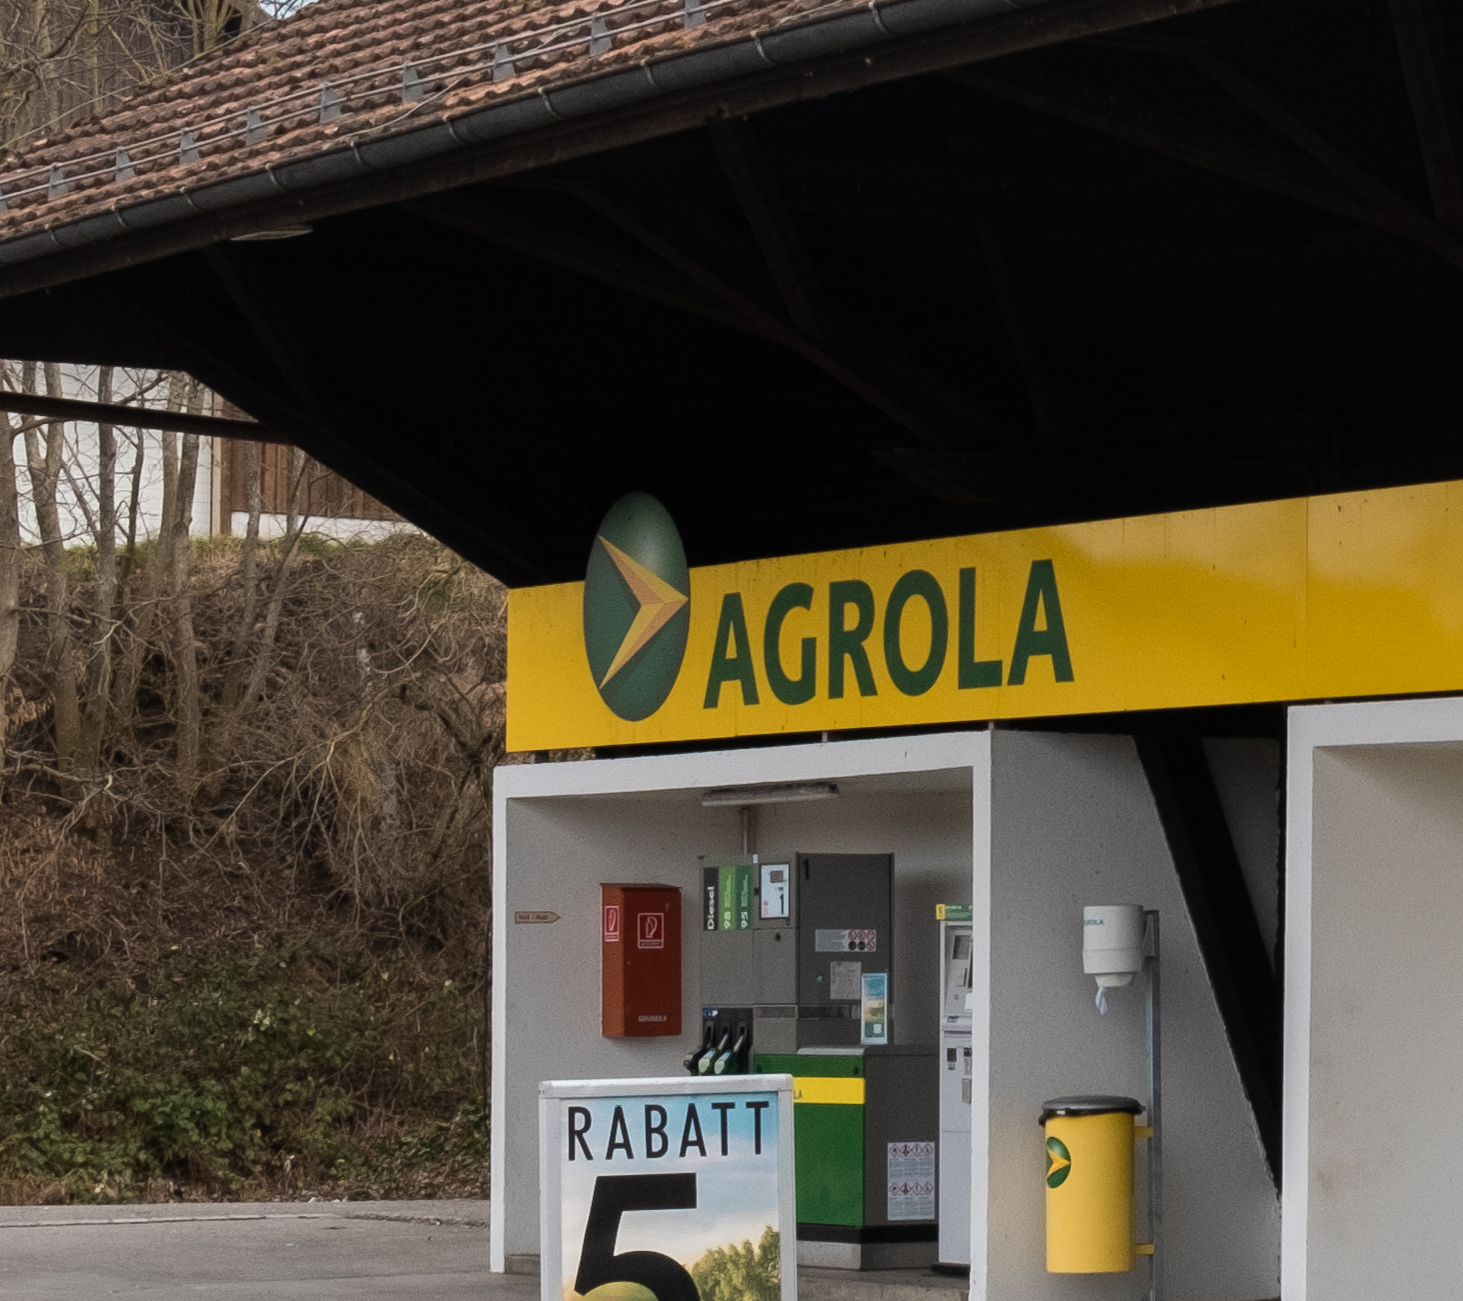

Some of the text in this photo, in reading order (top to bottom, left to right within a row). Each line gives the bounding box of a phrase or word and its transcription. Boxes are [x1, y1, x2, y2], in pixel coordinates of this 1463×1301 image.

[703, 558, 1075, 710] AGROLA
[779, 893, 784, 915] 1
[567, 1101, 770, 1161] RABATT
